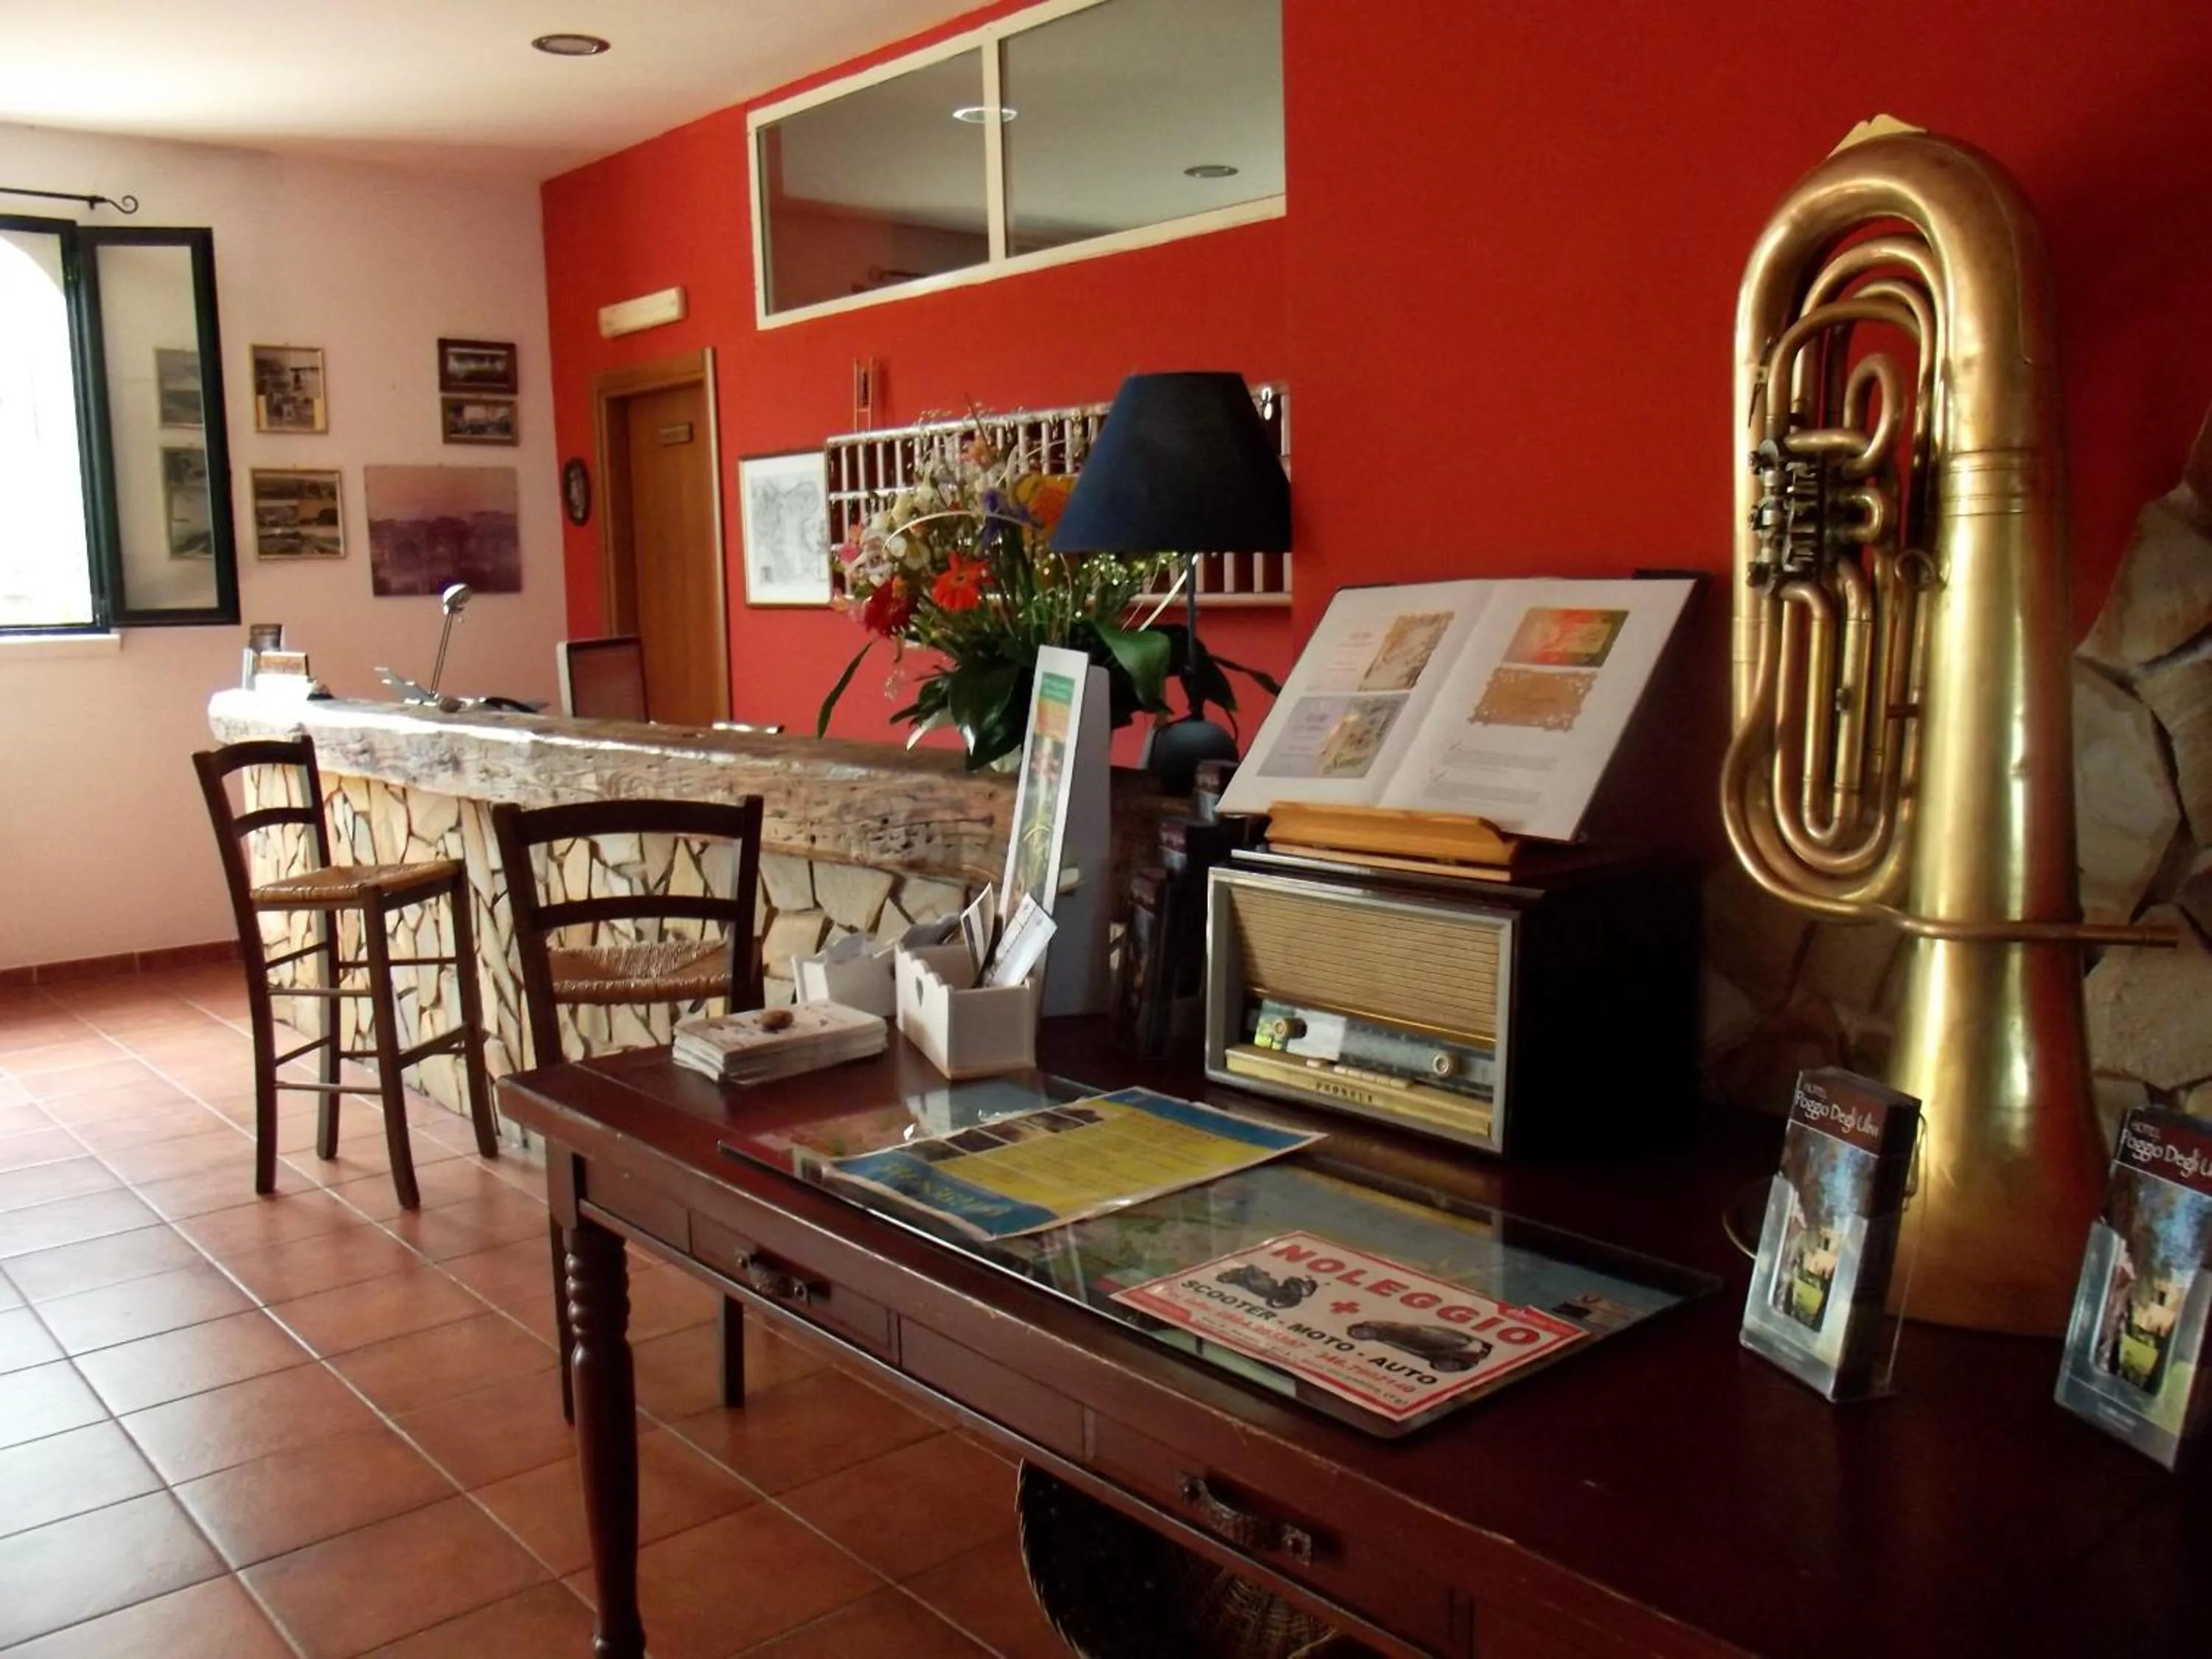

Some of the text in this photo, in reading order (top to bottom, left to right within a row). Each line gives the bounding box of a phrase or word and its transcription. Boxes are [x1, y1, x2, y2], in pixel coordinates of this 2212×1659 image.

[1181, 1279, 1278, 1321] SCOOTER
[1287, 1323, 1355, 1352] MOTO
[1367, 1356, 1438, 1385] AUTO
[1270, 1243, 1541, 1346] NOLEGGIO
